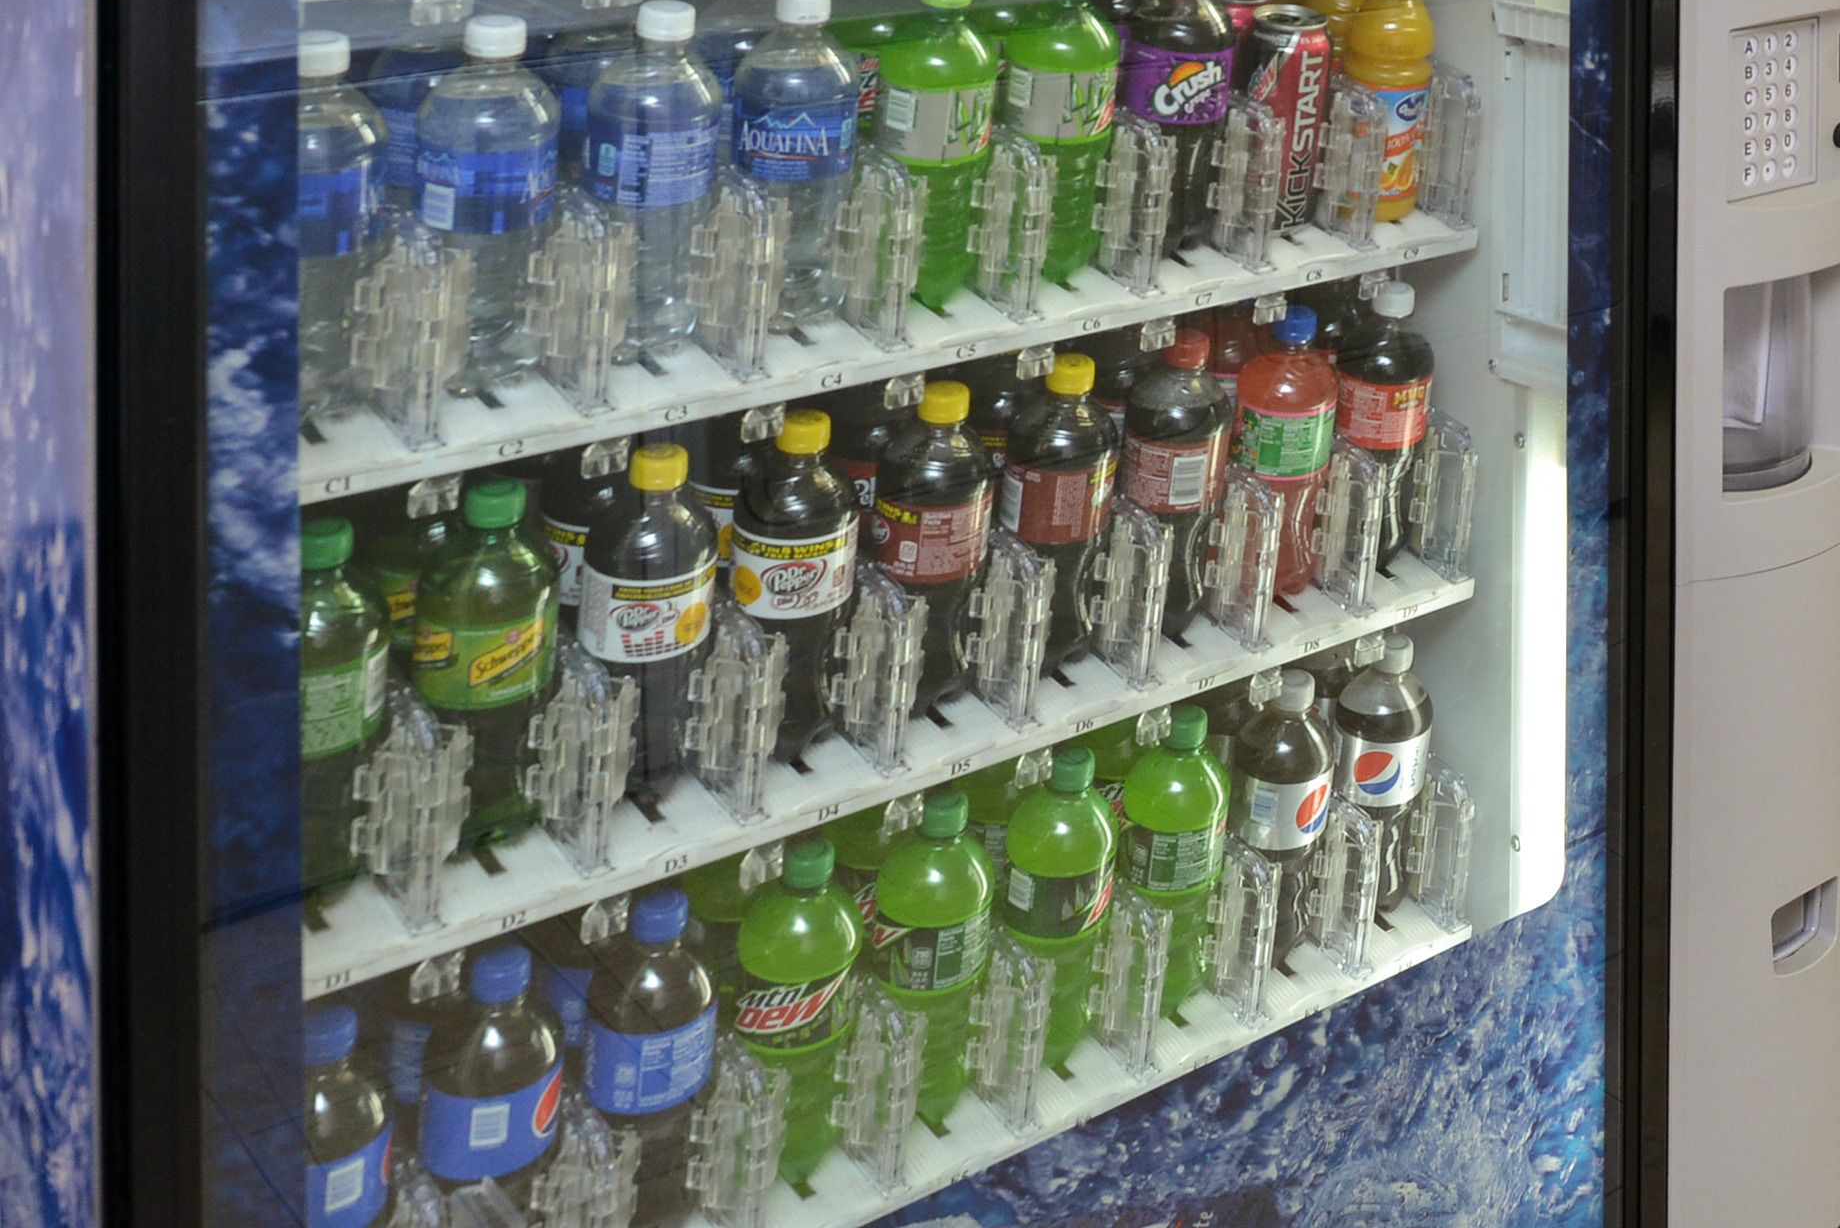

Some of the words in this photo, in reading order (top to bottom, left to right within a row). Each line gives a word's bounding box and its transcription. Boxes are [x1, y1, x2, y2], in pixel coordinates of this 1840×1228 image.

[1154, 60, 1223, 117] Crush
[738, 120, 829, 157] AQUAFINA
[1403, 248, 1419, 260] C9
[1306, 269, 1323, 281] C8
[1195, 293, 1212, 306] C7
[1082, 318, 1101, 331] C6
[956, 344, 976, 358] C5
[821, 373, 843, 388] C4
[1394, 385, 1425, 405] MUG
[664, 405, 689, 420] C3
[499, 440, 525, 455] C2
[326, 477, 352, 493] C1
[774, 569, 818, 592] Pepper
[1402, 606, 1419, 617] D9
[1304, 640, 1321, 652] D8
[476, 636, 536, 679] Schweppe
[1199, 676, 1217, 689] D7
[1075, 719, 1094, 733] D6
[950, 759, 972, 774] D5
[818, 805, 841, 821] D4
[664, 856, 688, 872] D3
[502, 911, 528, 928] D2
[326, 972, 352, 988] D1
